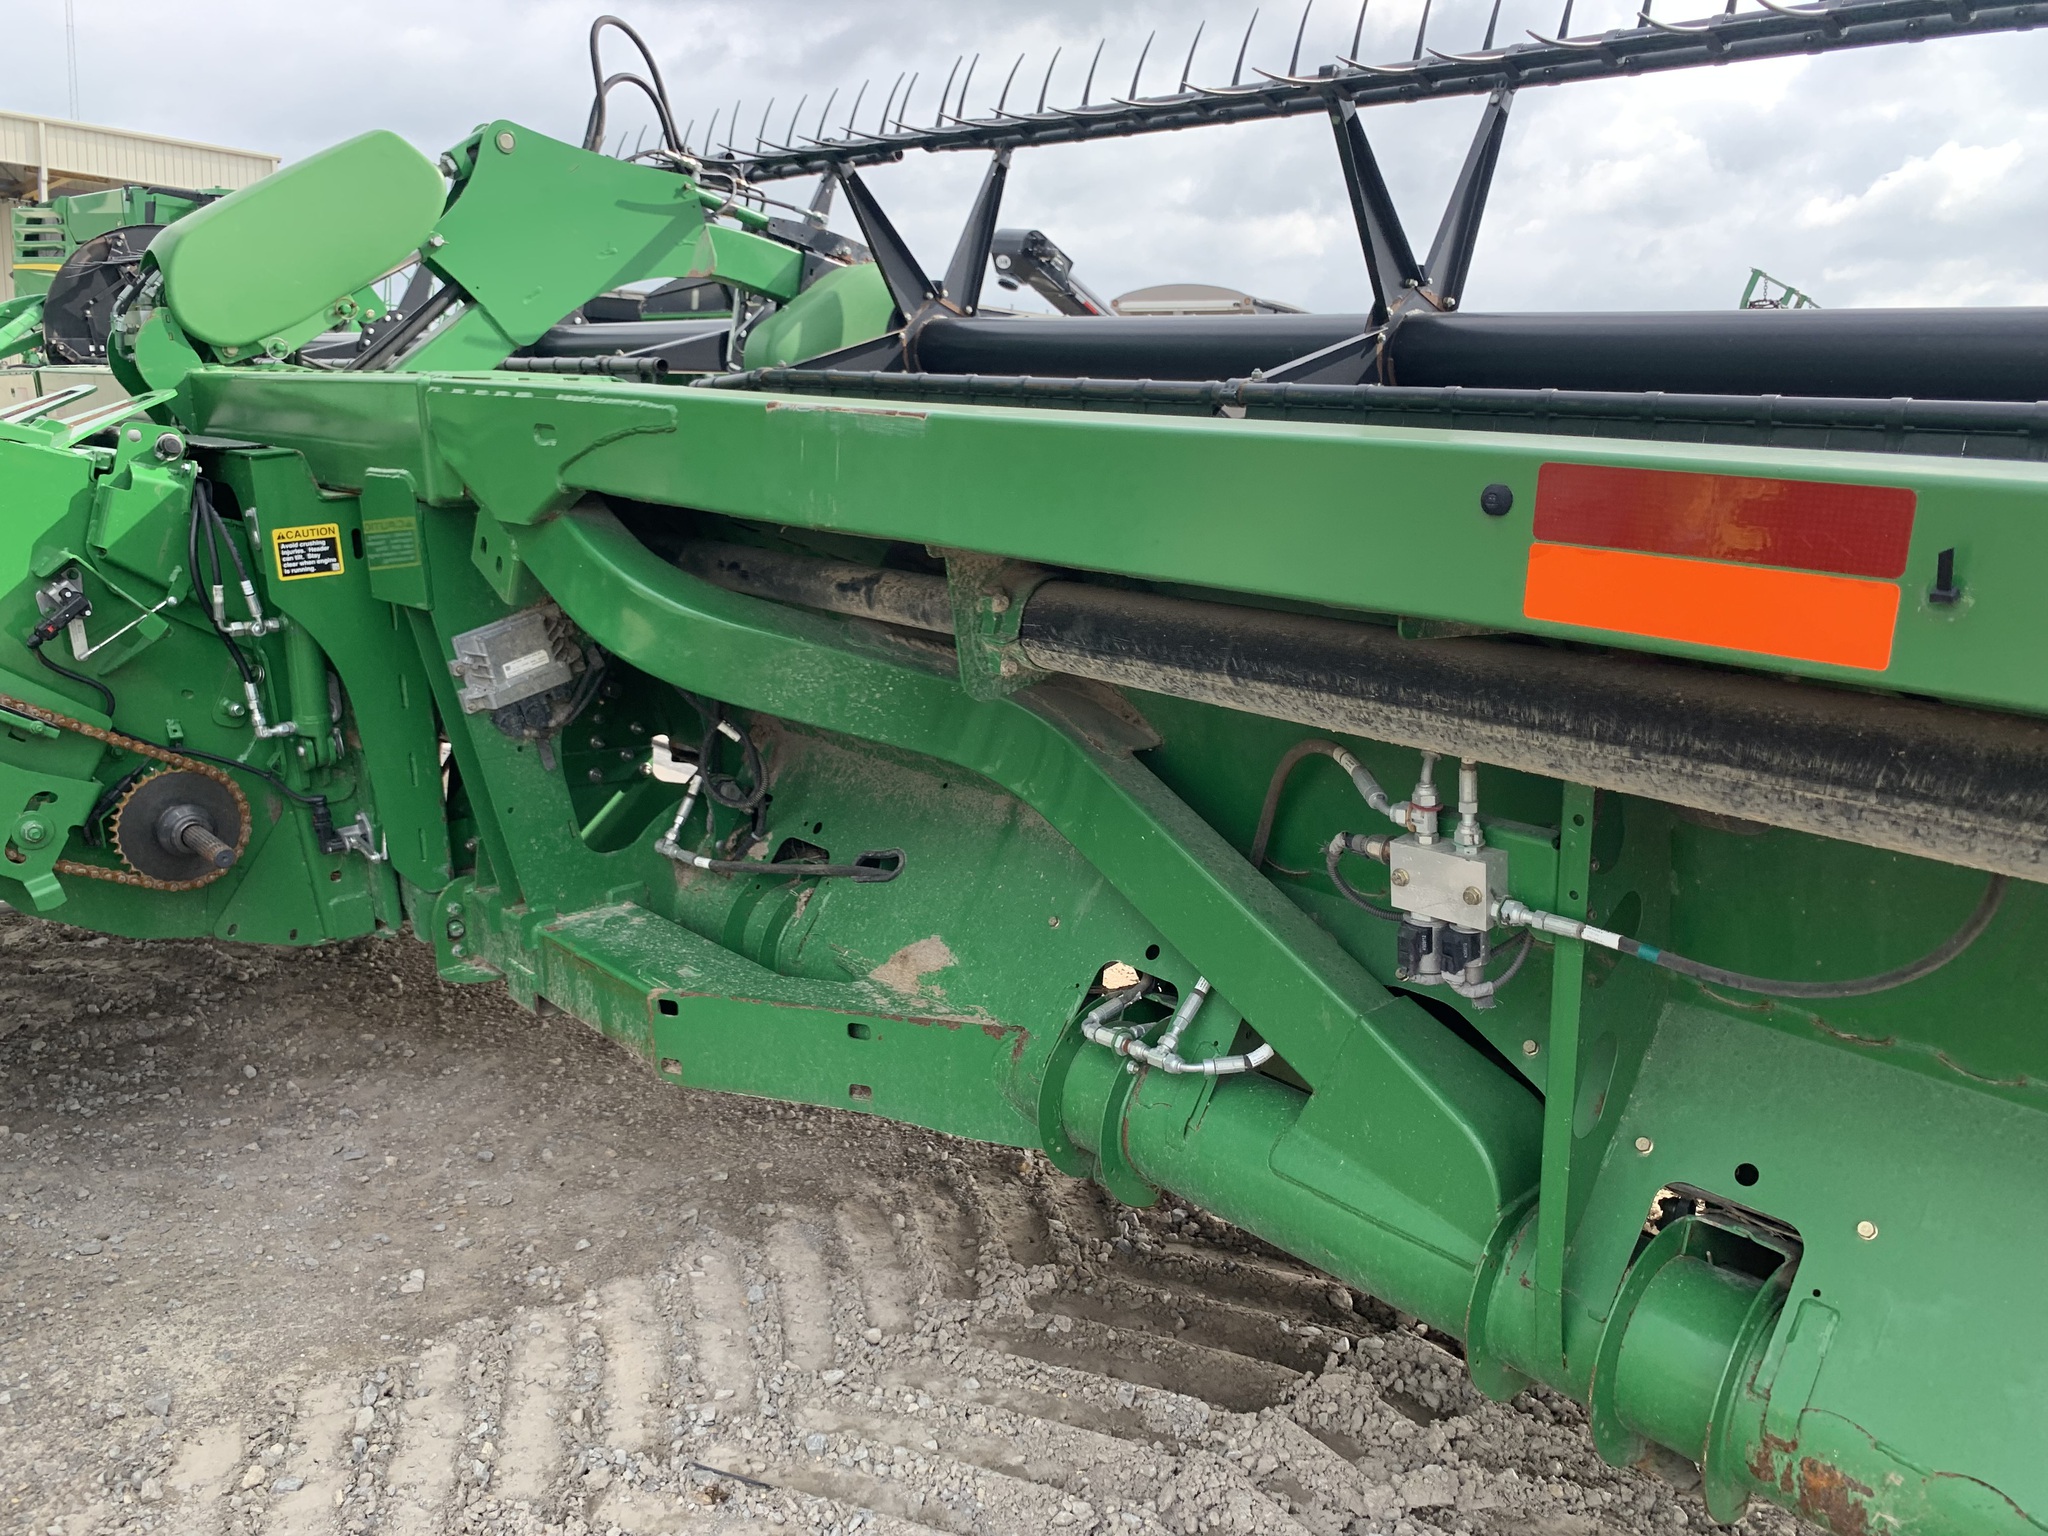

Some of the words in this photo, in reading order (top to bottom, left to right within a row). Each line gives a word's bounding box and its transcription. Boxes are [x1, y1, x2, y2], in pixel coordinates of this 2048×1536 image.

[286, 526, 336, 540] CAUTION
[317, 557, 337, 565] engine
[291, 566, 317, 574] running.
